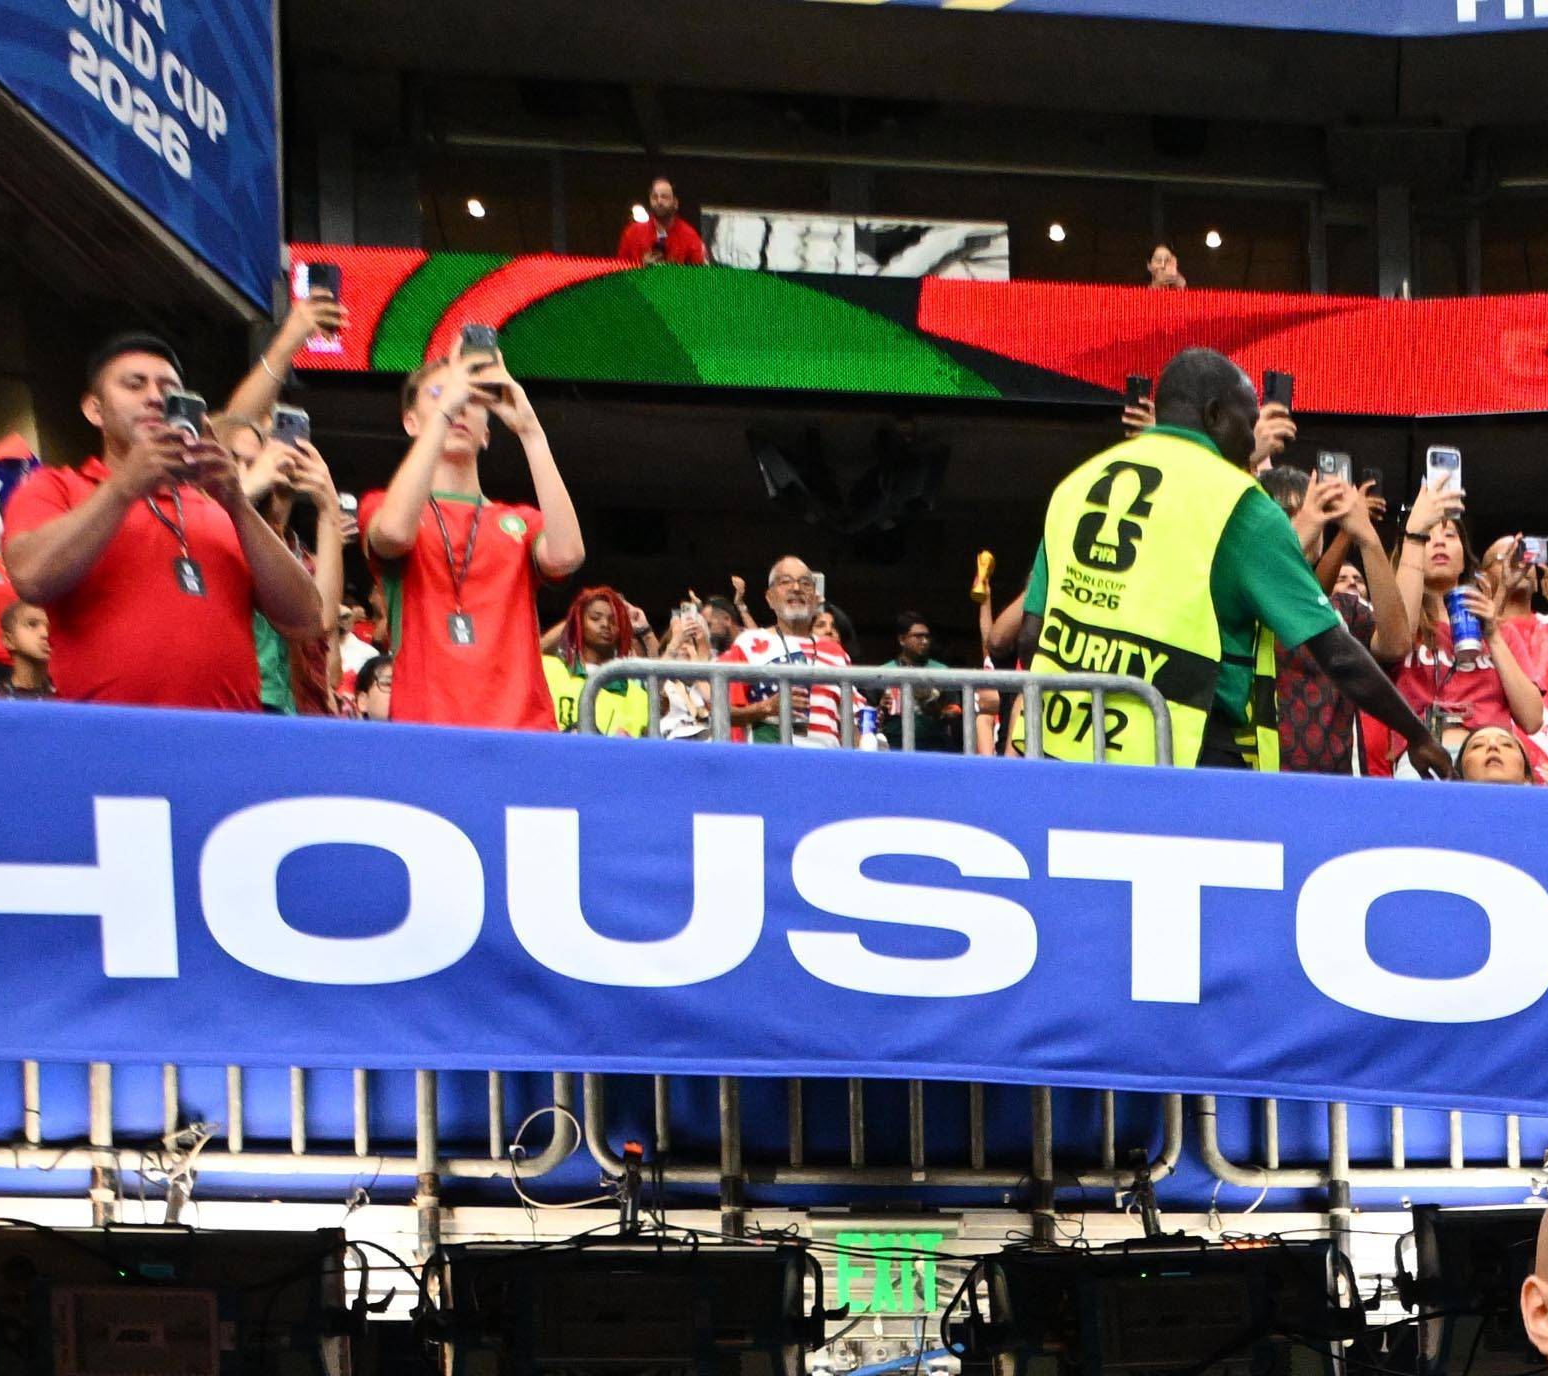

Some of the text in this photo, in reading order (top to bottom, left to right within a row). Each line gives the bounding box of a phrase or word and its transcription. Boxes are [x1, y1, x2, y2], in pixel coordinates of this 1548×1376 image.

[68, 28, 192, 180] 2026
[161, 50, 227, 144] CUP
[1065, 564, 1101, 587] WORLD
[1088, 543, 1117, 565] FIFA
[1060, 578, 1121, 611] 2026
[1021, 694, 1129, 752] 072
[835, 1232, 944, 1313] EXIT
